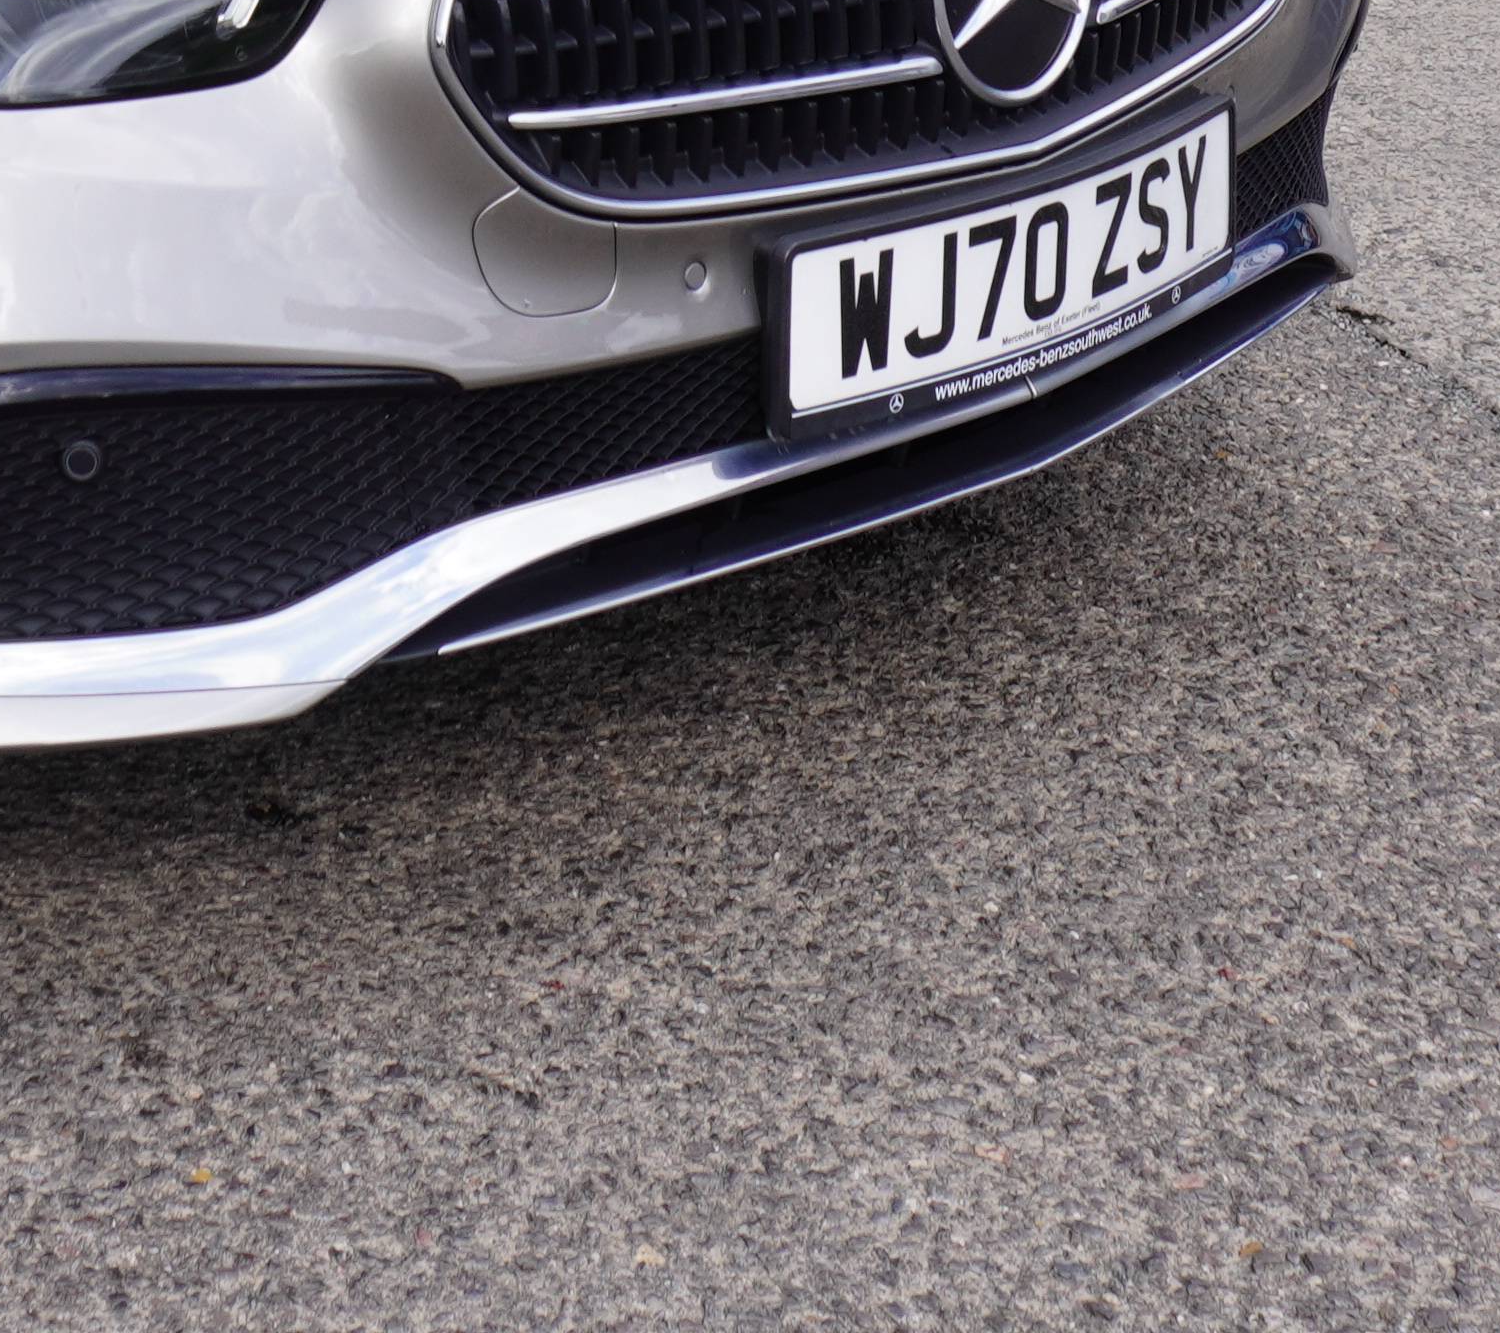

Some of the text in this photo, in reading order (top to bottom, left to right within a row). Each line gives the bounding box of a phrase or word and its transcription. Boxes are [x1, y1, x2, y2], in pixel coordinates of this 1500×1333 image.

[838, 133, 1207, 380] WJ70 ZSY
[1002, 328, 1035, 347] Mercedes
